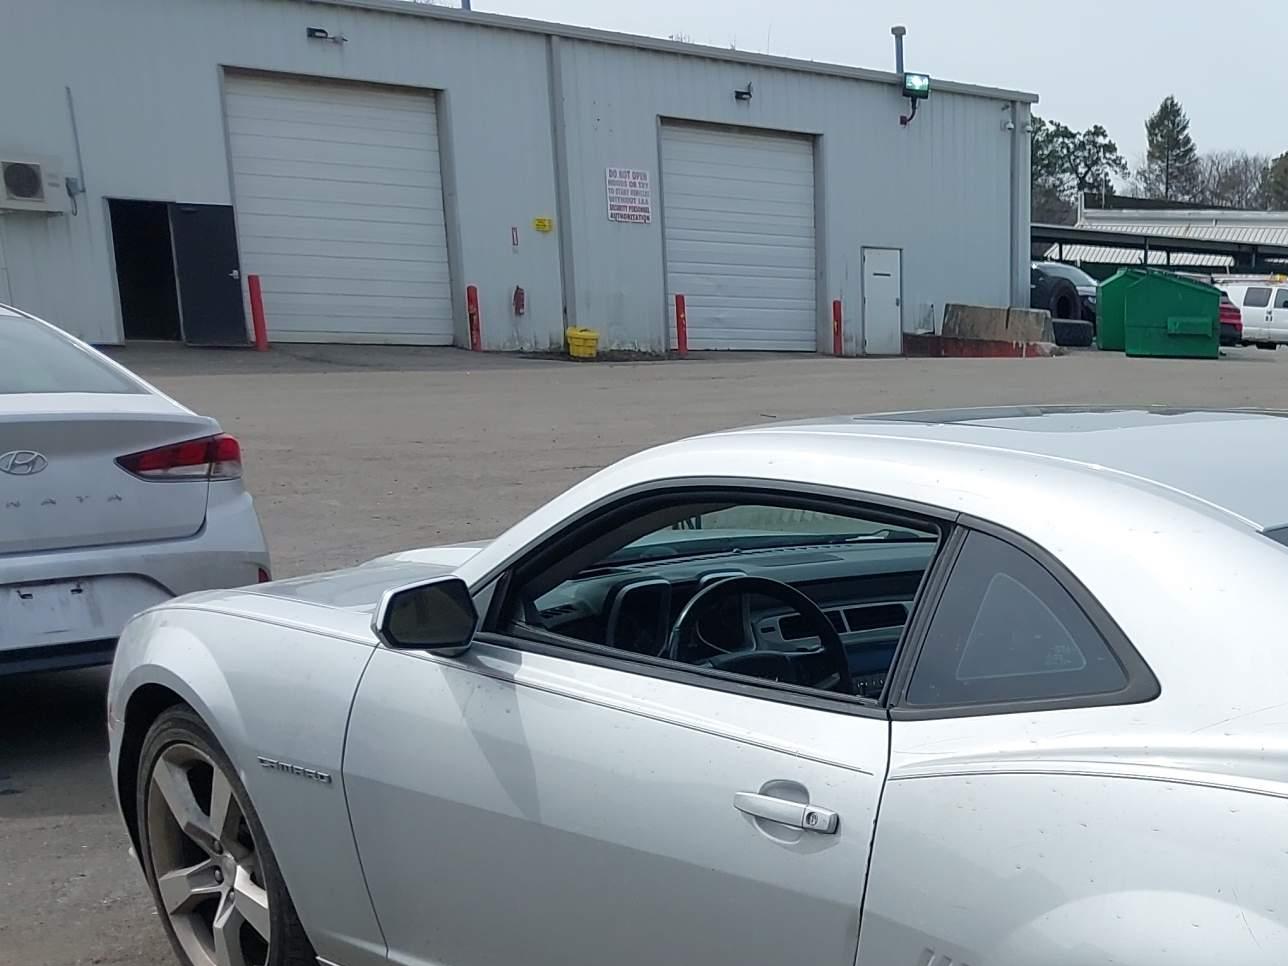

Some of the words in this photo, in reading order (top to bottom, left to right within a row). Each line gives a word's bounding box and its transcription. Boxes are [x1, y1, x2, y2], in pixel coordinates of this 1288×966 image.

[609, 169, 618, 178] DO
[619, 170, 630, 179] NOT
[631, 171, 647, 181] OPEN
[257, 756, 333, 784] CAMARO
